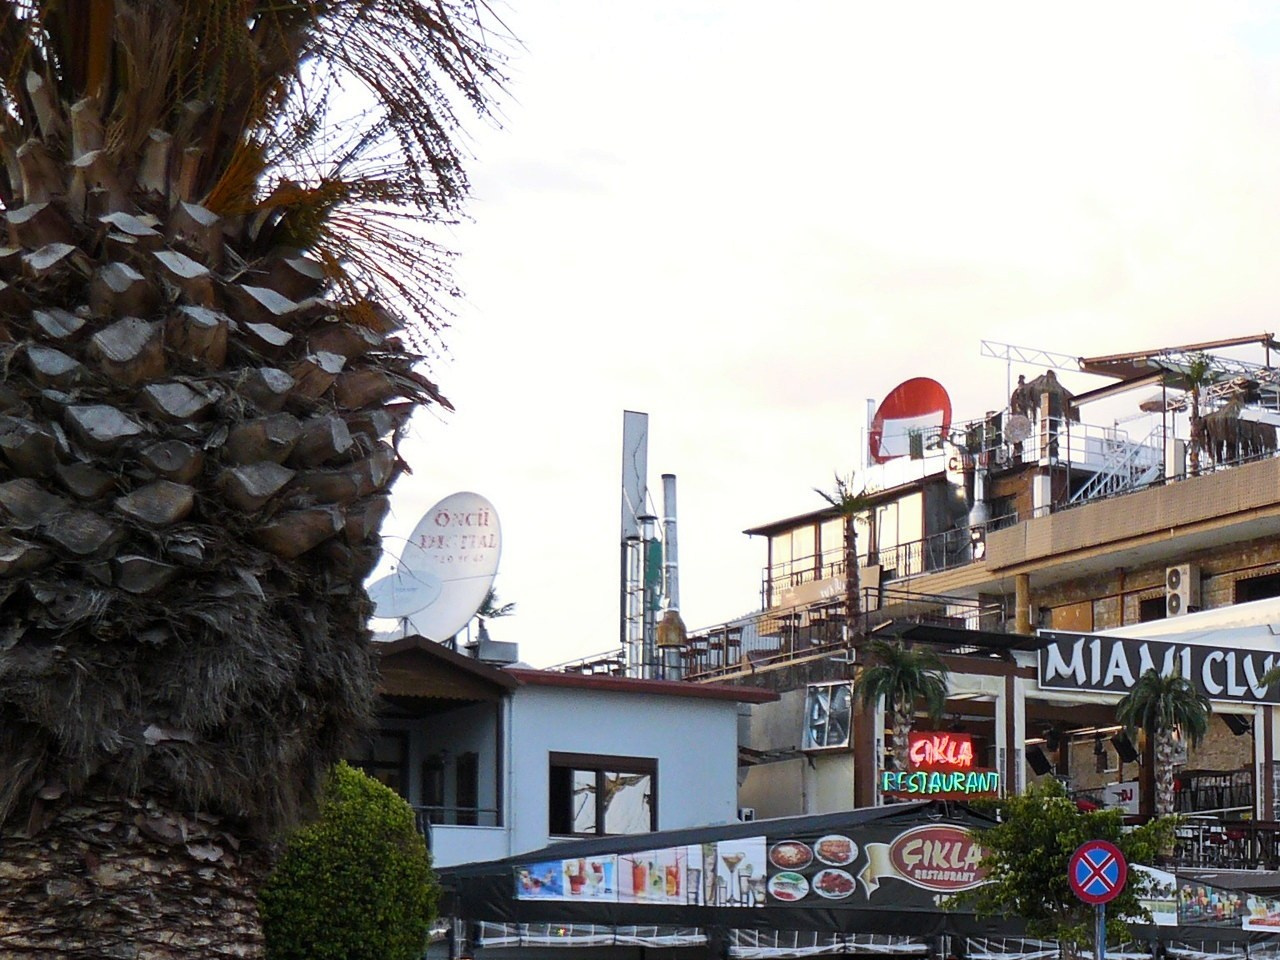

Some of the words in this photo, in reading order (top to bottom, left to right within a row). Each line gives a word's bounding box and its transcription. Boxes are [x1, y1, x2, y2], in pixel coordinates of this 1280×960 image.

[1045, 635, 1191, 688] MIAMI
[910, 735, 973, 767] ÇIKLA
[883, 771, 999, 794] RESTAURANT
[902, 839, 982, 871] ÇIKLA
[915, 869, 976, 882] RESTAURANT
